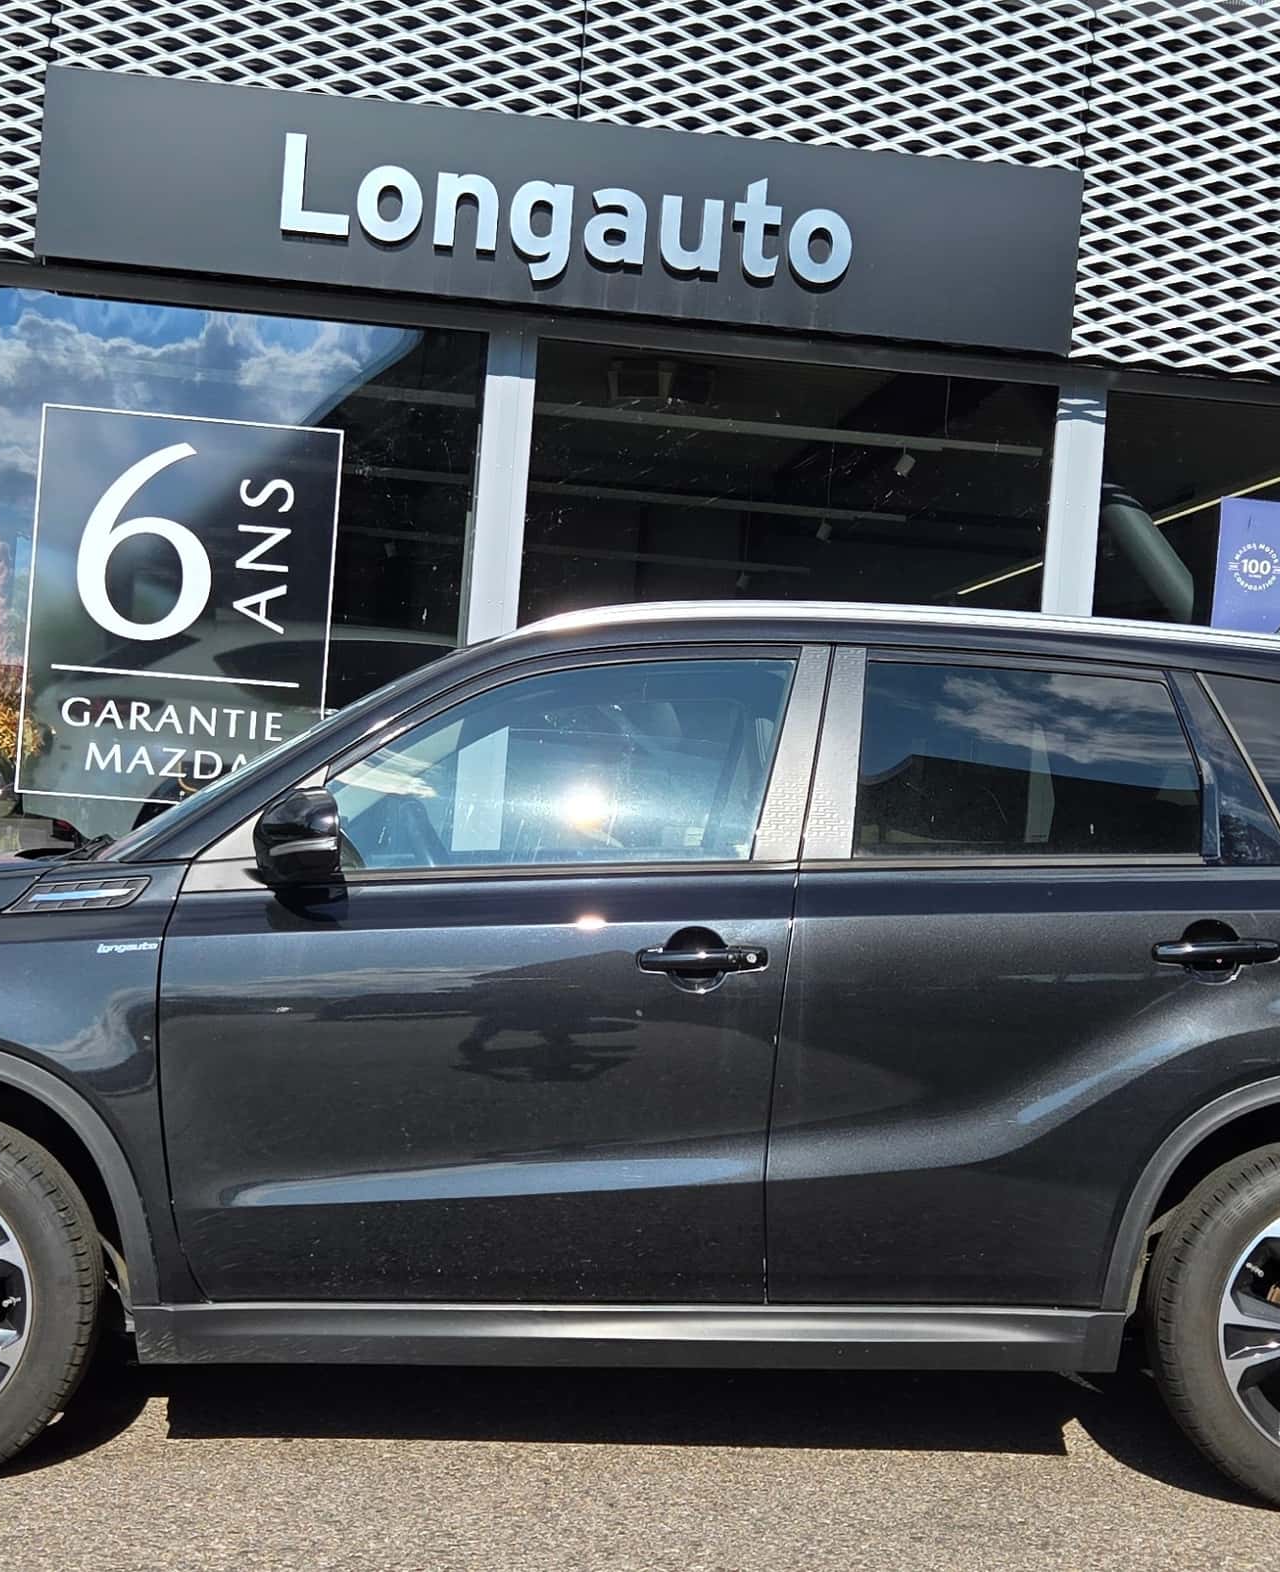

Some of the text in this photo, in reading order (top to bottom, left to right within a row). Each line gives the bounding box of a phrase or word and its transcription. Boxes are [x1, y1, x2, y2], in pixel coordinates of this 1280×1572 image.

[279, 132, 854, 284] Longauto
[76, 442, 294, 641] 6 ANS
[1240, 559, 1272, 575] 100
[61, 696, 283, 742] GARANTIE
